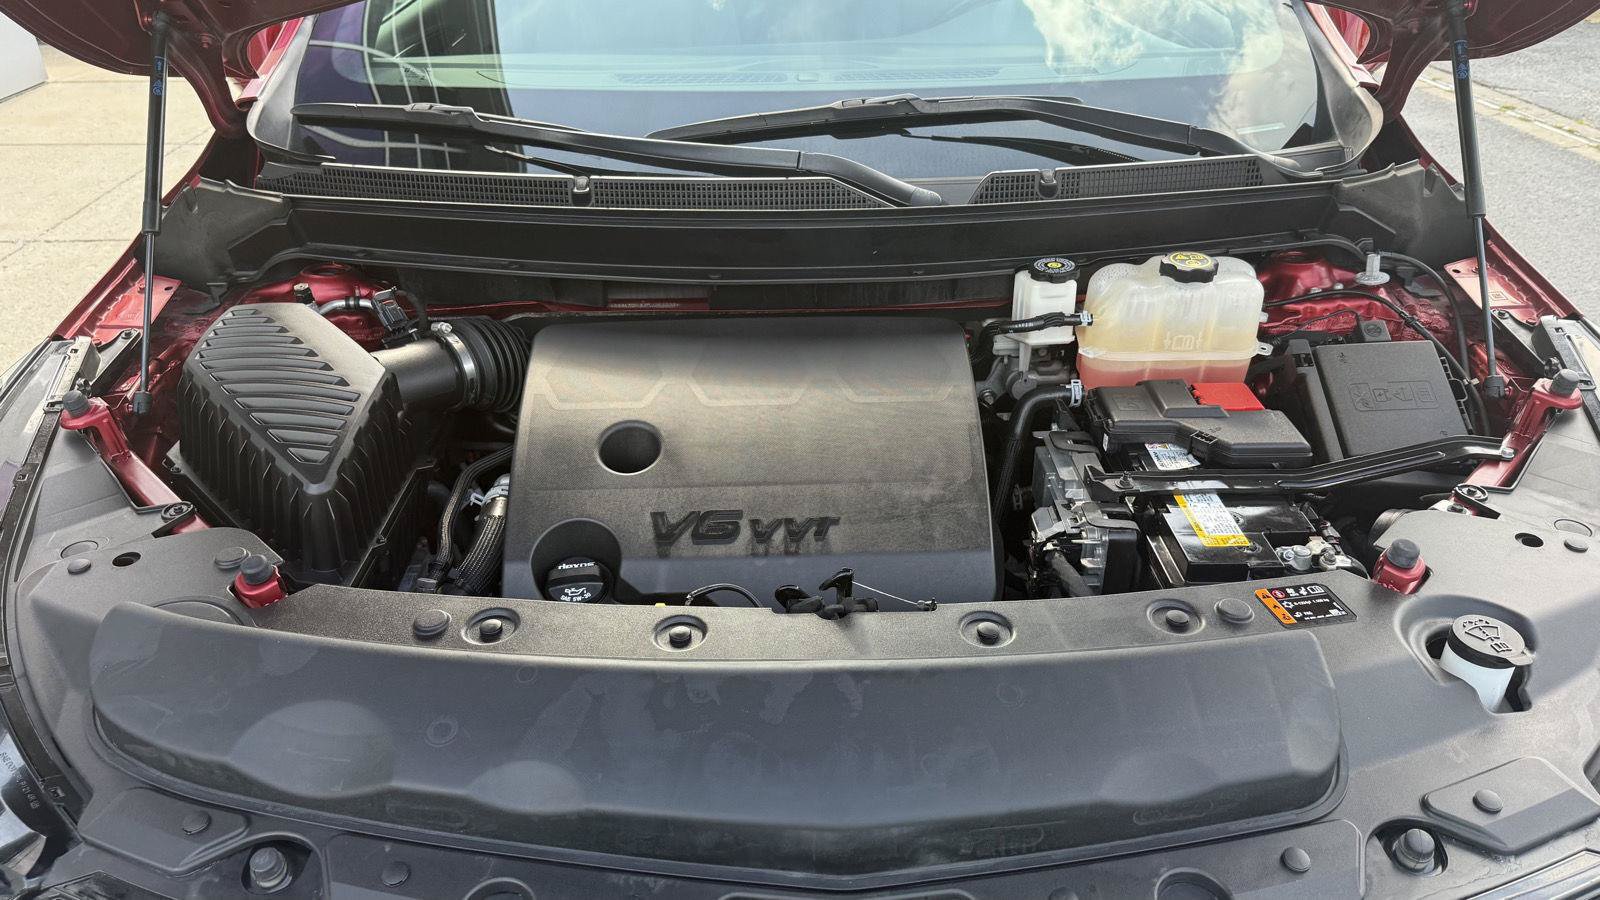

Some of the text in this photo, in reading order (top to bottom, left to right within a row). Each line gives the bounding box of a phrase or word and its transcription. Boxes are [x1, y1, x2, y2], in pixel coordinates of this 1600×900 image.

[650, 510, 841, 545] V6 VVT
[558, 561, 595, 570] dexos
[572, 592, 592, 602] 5W-30
